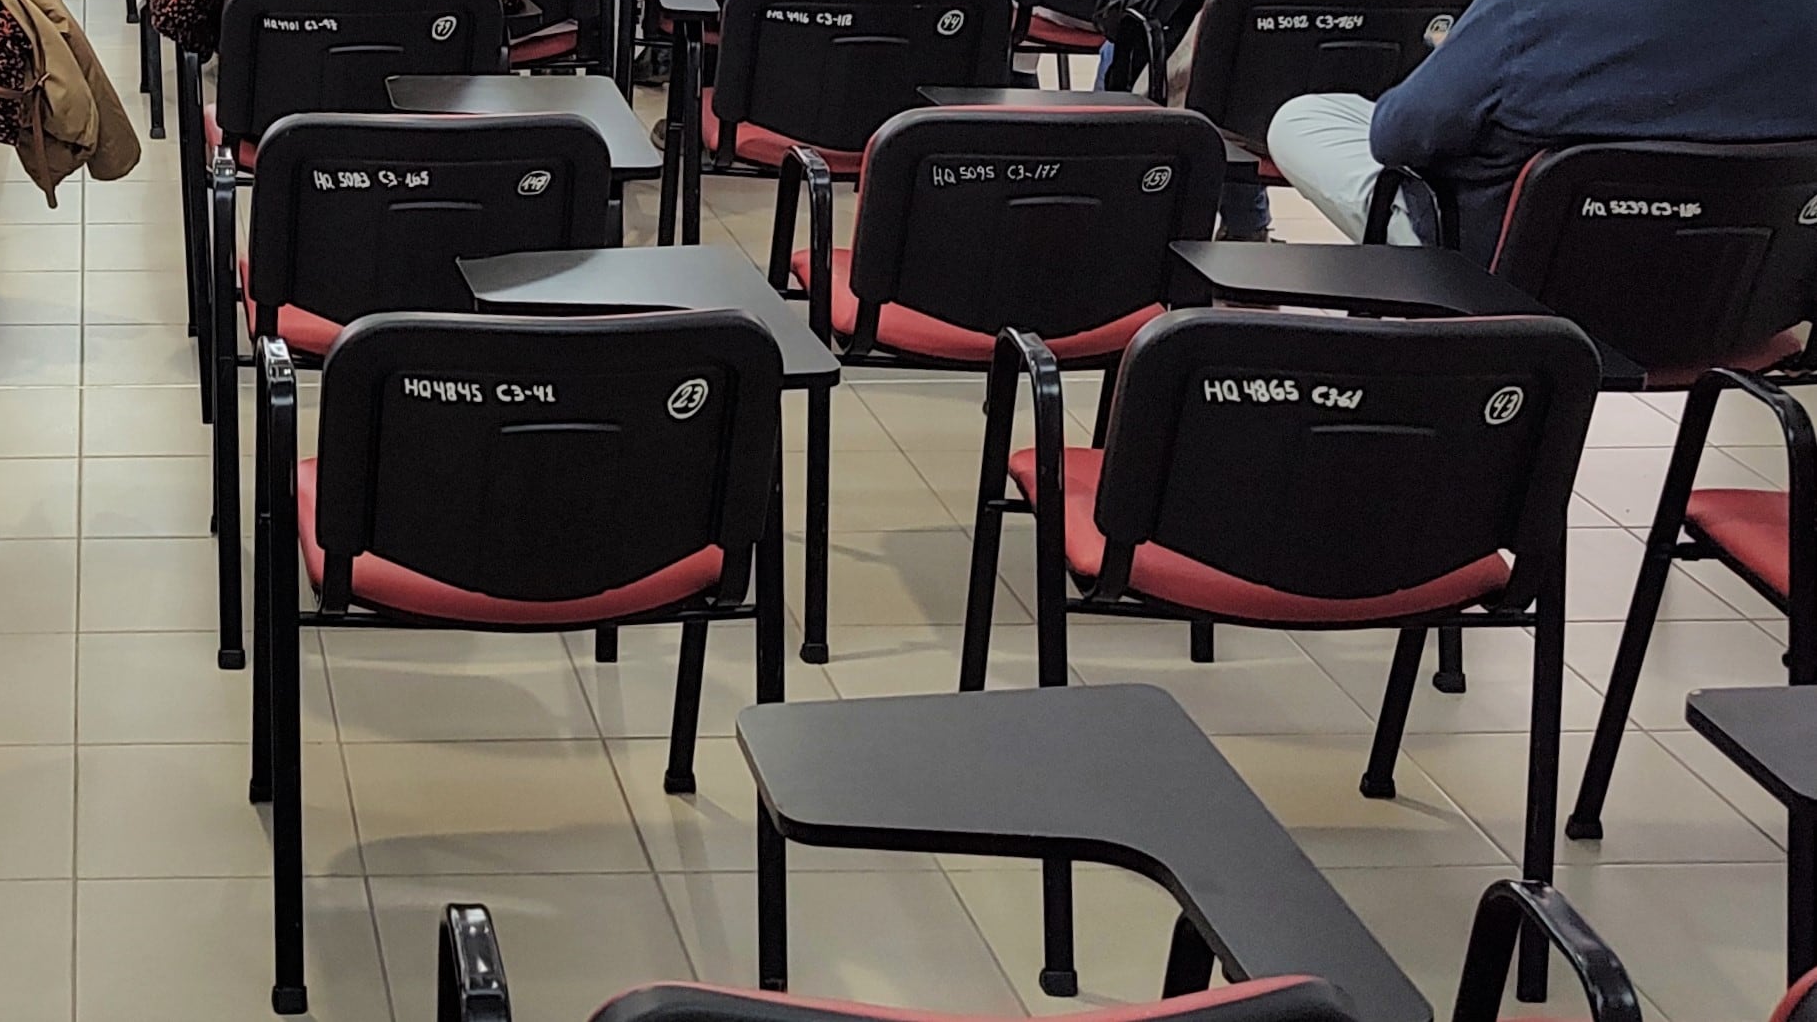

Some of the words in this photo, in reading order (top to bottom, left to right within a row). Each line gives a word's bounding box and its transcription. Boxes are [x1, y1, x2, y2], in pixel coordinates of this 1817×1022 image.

[1257, 17, 1275, 31] HQ
[933, 165, 956, 186] HQ
[959, 165, 995, 182] 5095
[1007, 163, 1060, 181] C3-177
[1142, 168, 1170, 188] 159
[1583, 197, 1607, 216] HQ
[495, 384, 556, 402] C3-41
[670, 383, 705, 412] 23
[1490, 390, 1521, 420] 43
